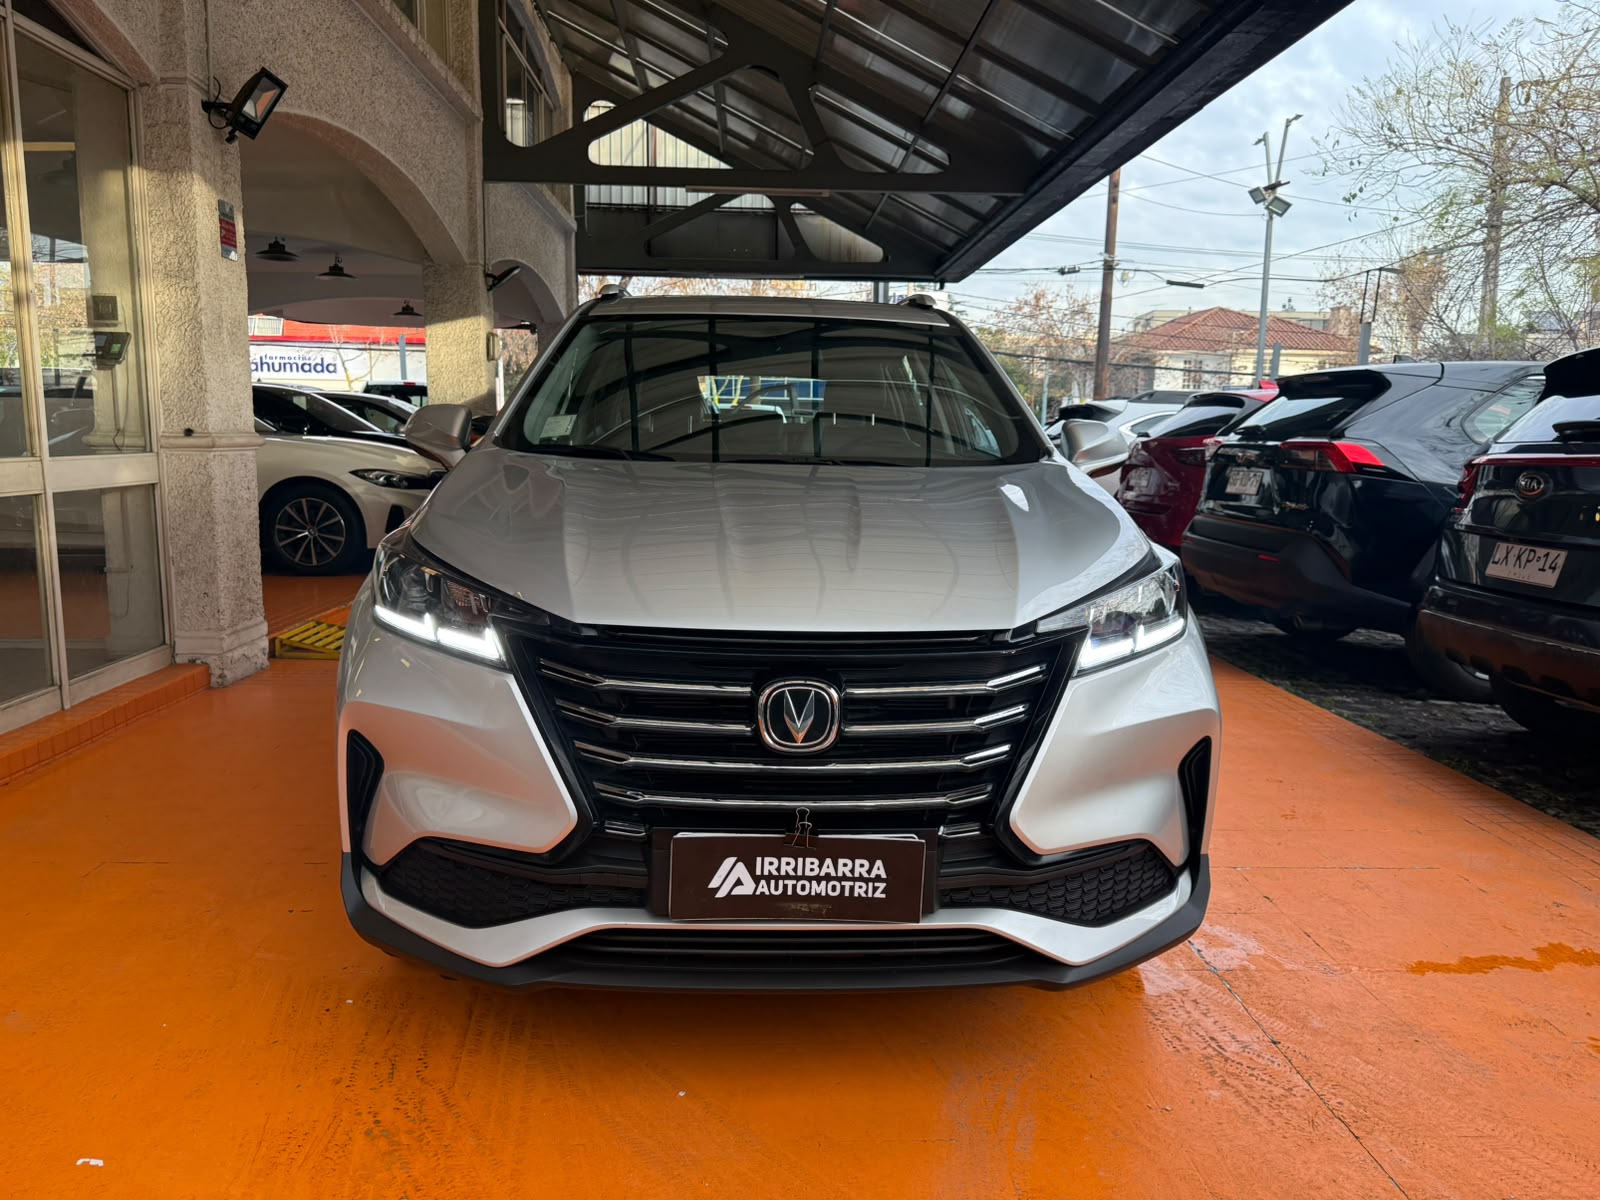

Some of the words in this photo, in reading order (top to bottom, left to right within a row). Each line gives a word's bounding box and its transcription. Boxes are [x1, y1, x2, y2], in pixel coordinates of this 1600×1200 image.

[251, 355, 337, 374] ahumada
[756, 857, 887, 878] IRRIBARRA
[756, 880, 886, 898] AUTOMOTRIZ
